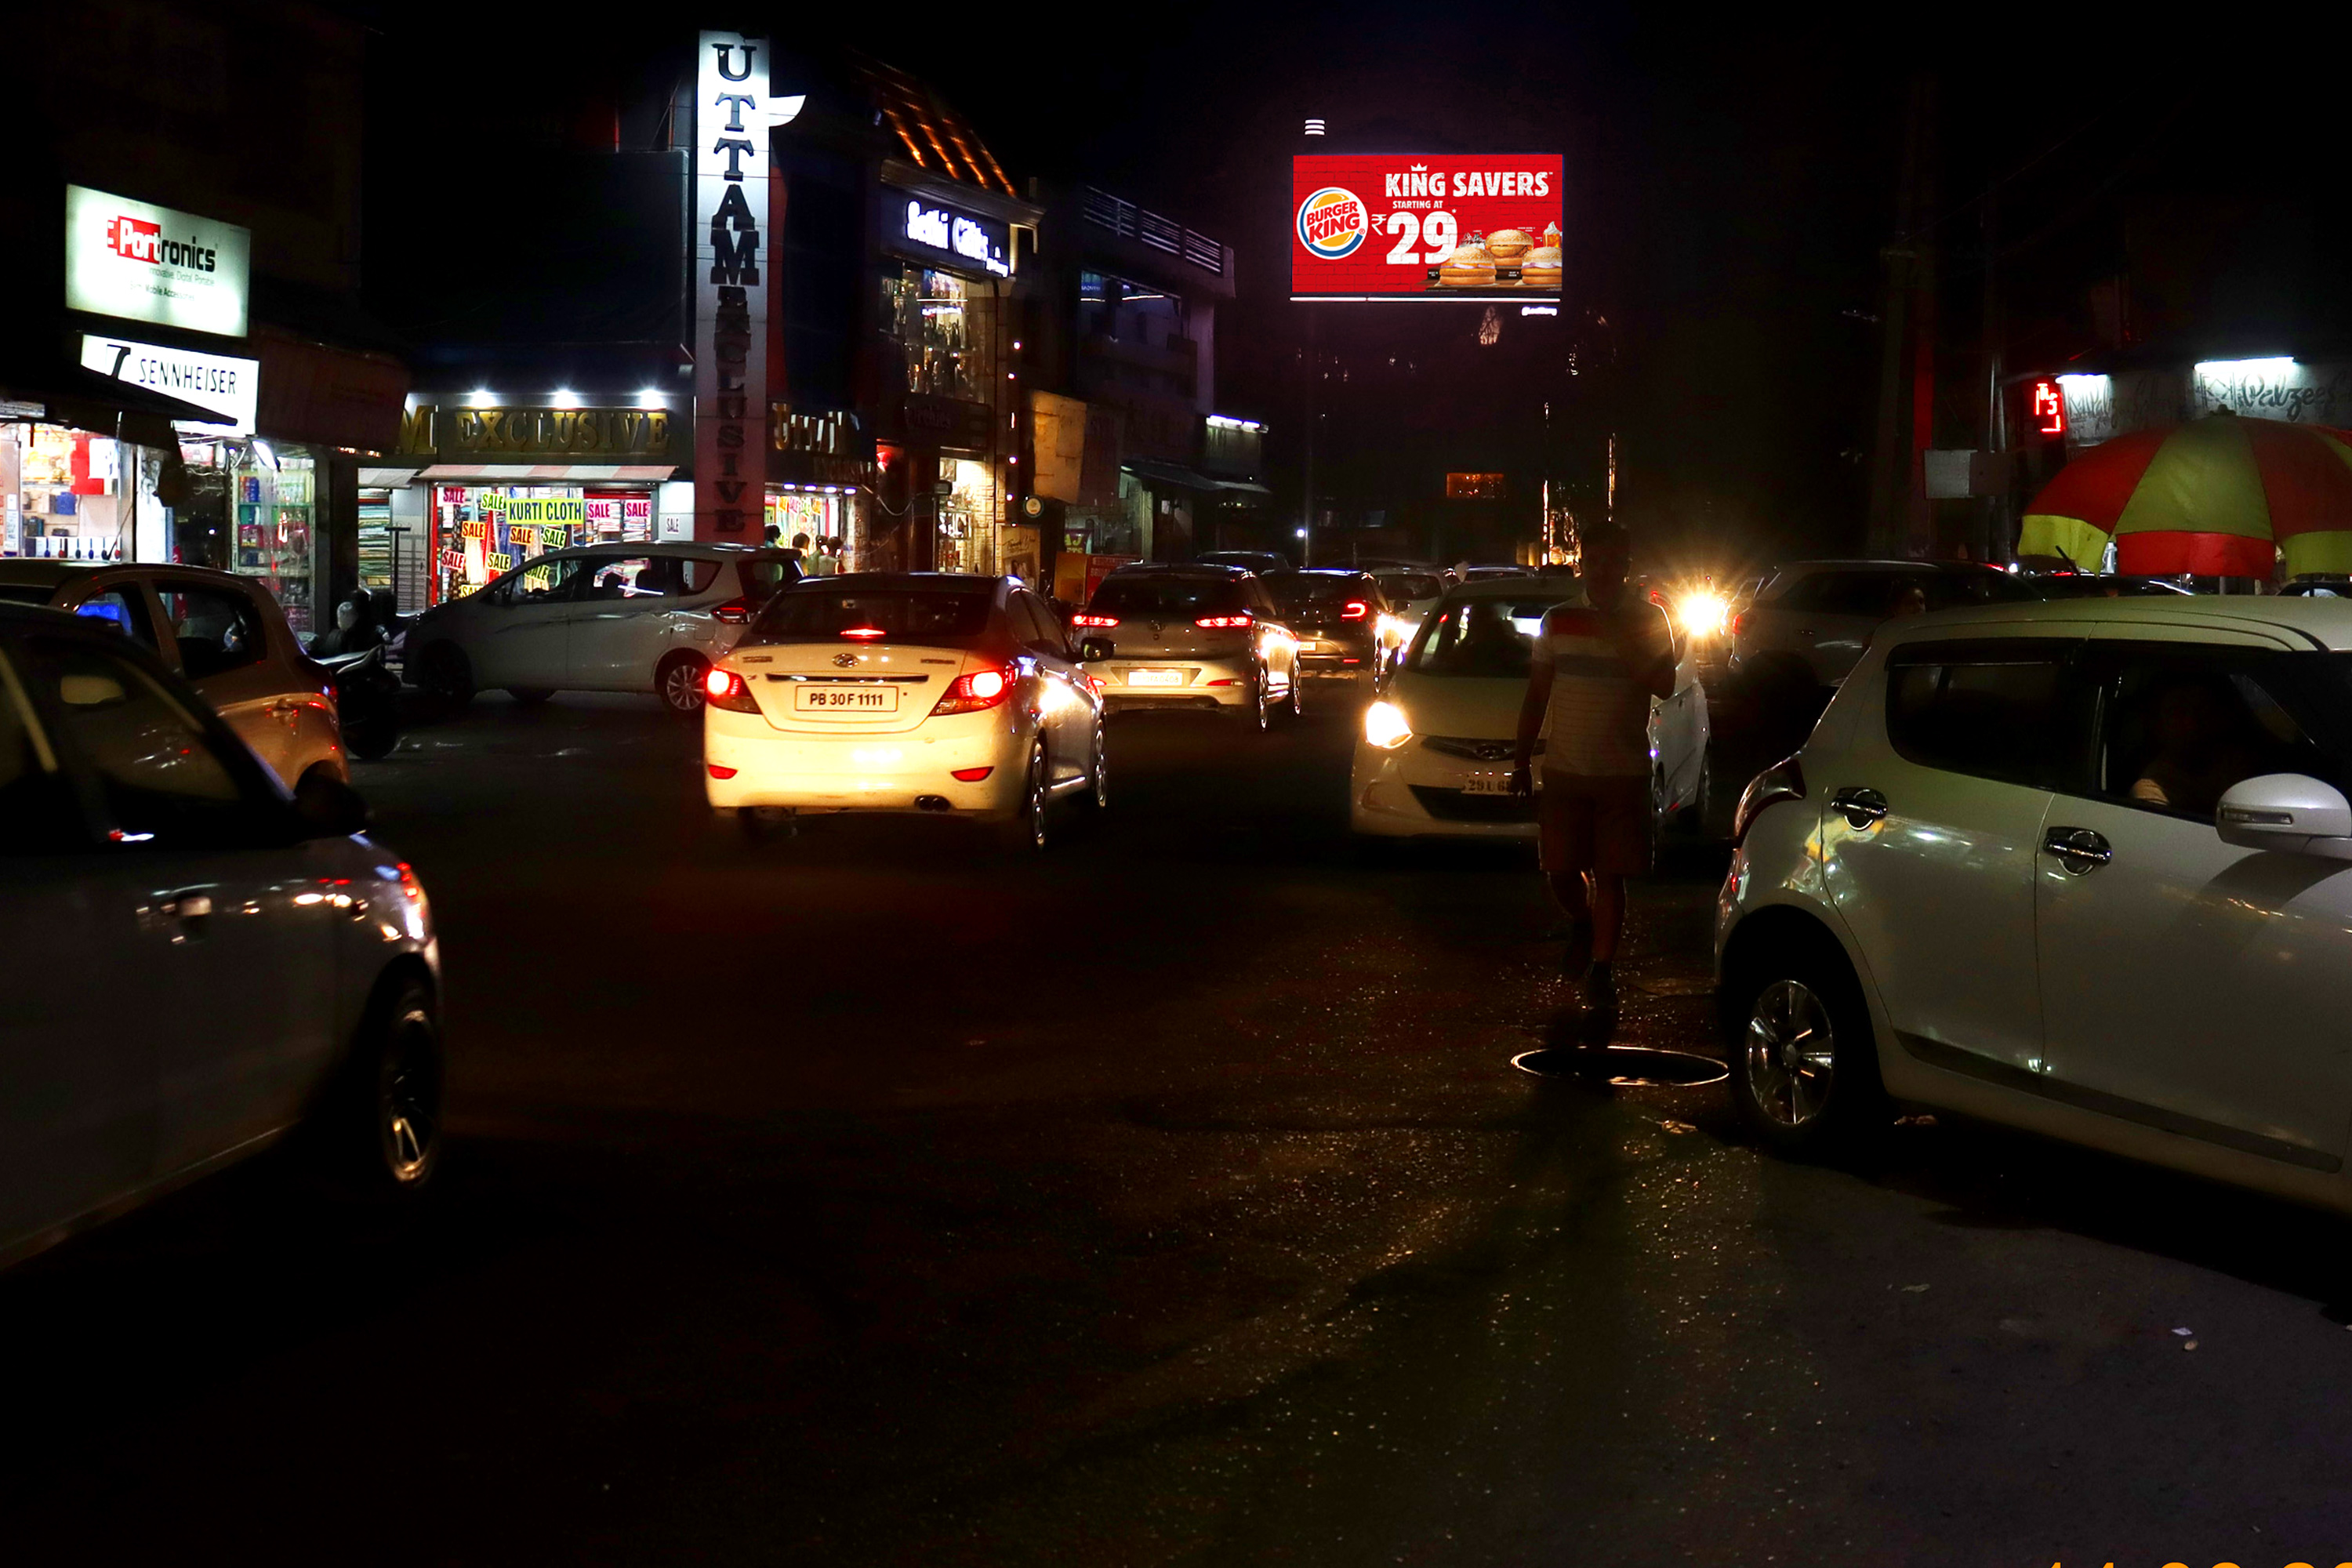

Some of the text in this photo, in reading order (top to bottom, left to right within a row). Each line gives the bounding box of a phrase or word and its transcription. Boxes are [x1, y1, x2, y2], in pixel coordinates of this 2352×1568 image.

[710, 42, 760, 285] UTTAM
[1385, 171, 1549, 197] KING SAVERS
[1392, 200, 1443, 209] STARTING AT
[1307, 201, 1358, 227] BURGER
[1308, 212, 1360, 244] KING
[119, 218, 216, 273] Portronics
[139, 358, 237, 394] SENNHEISER
[457, 411, 670, 451] EXCLUSIVE
[443, 488, 466, 504] SALE
[481, 493, 503, 510] SALE
[509, 501, 582, 521] KURTI CLOTH
[588, 503, 611, 519] SALE
[626, 502, 648, 517] SALE
[462, 523, 485, 538] SALE
[666, 517, 680, 533] SALE
[510, 528, 532, 543] SALE
[543, 528, 565, 546] SALE
[441, 551, 464, 569] SALE
[488, 554, 510, 570] SALE
[809, 692, 826, 706] PB
[858, 691, 884, 706] 1111
